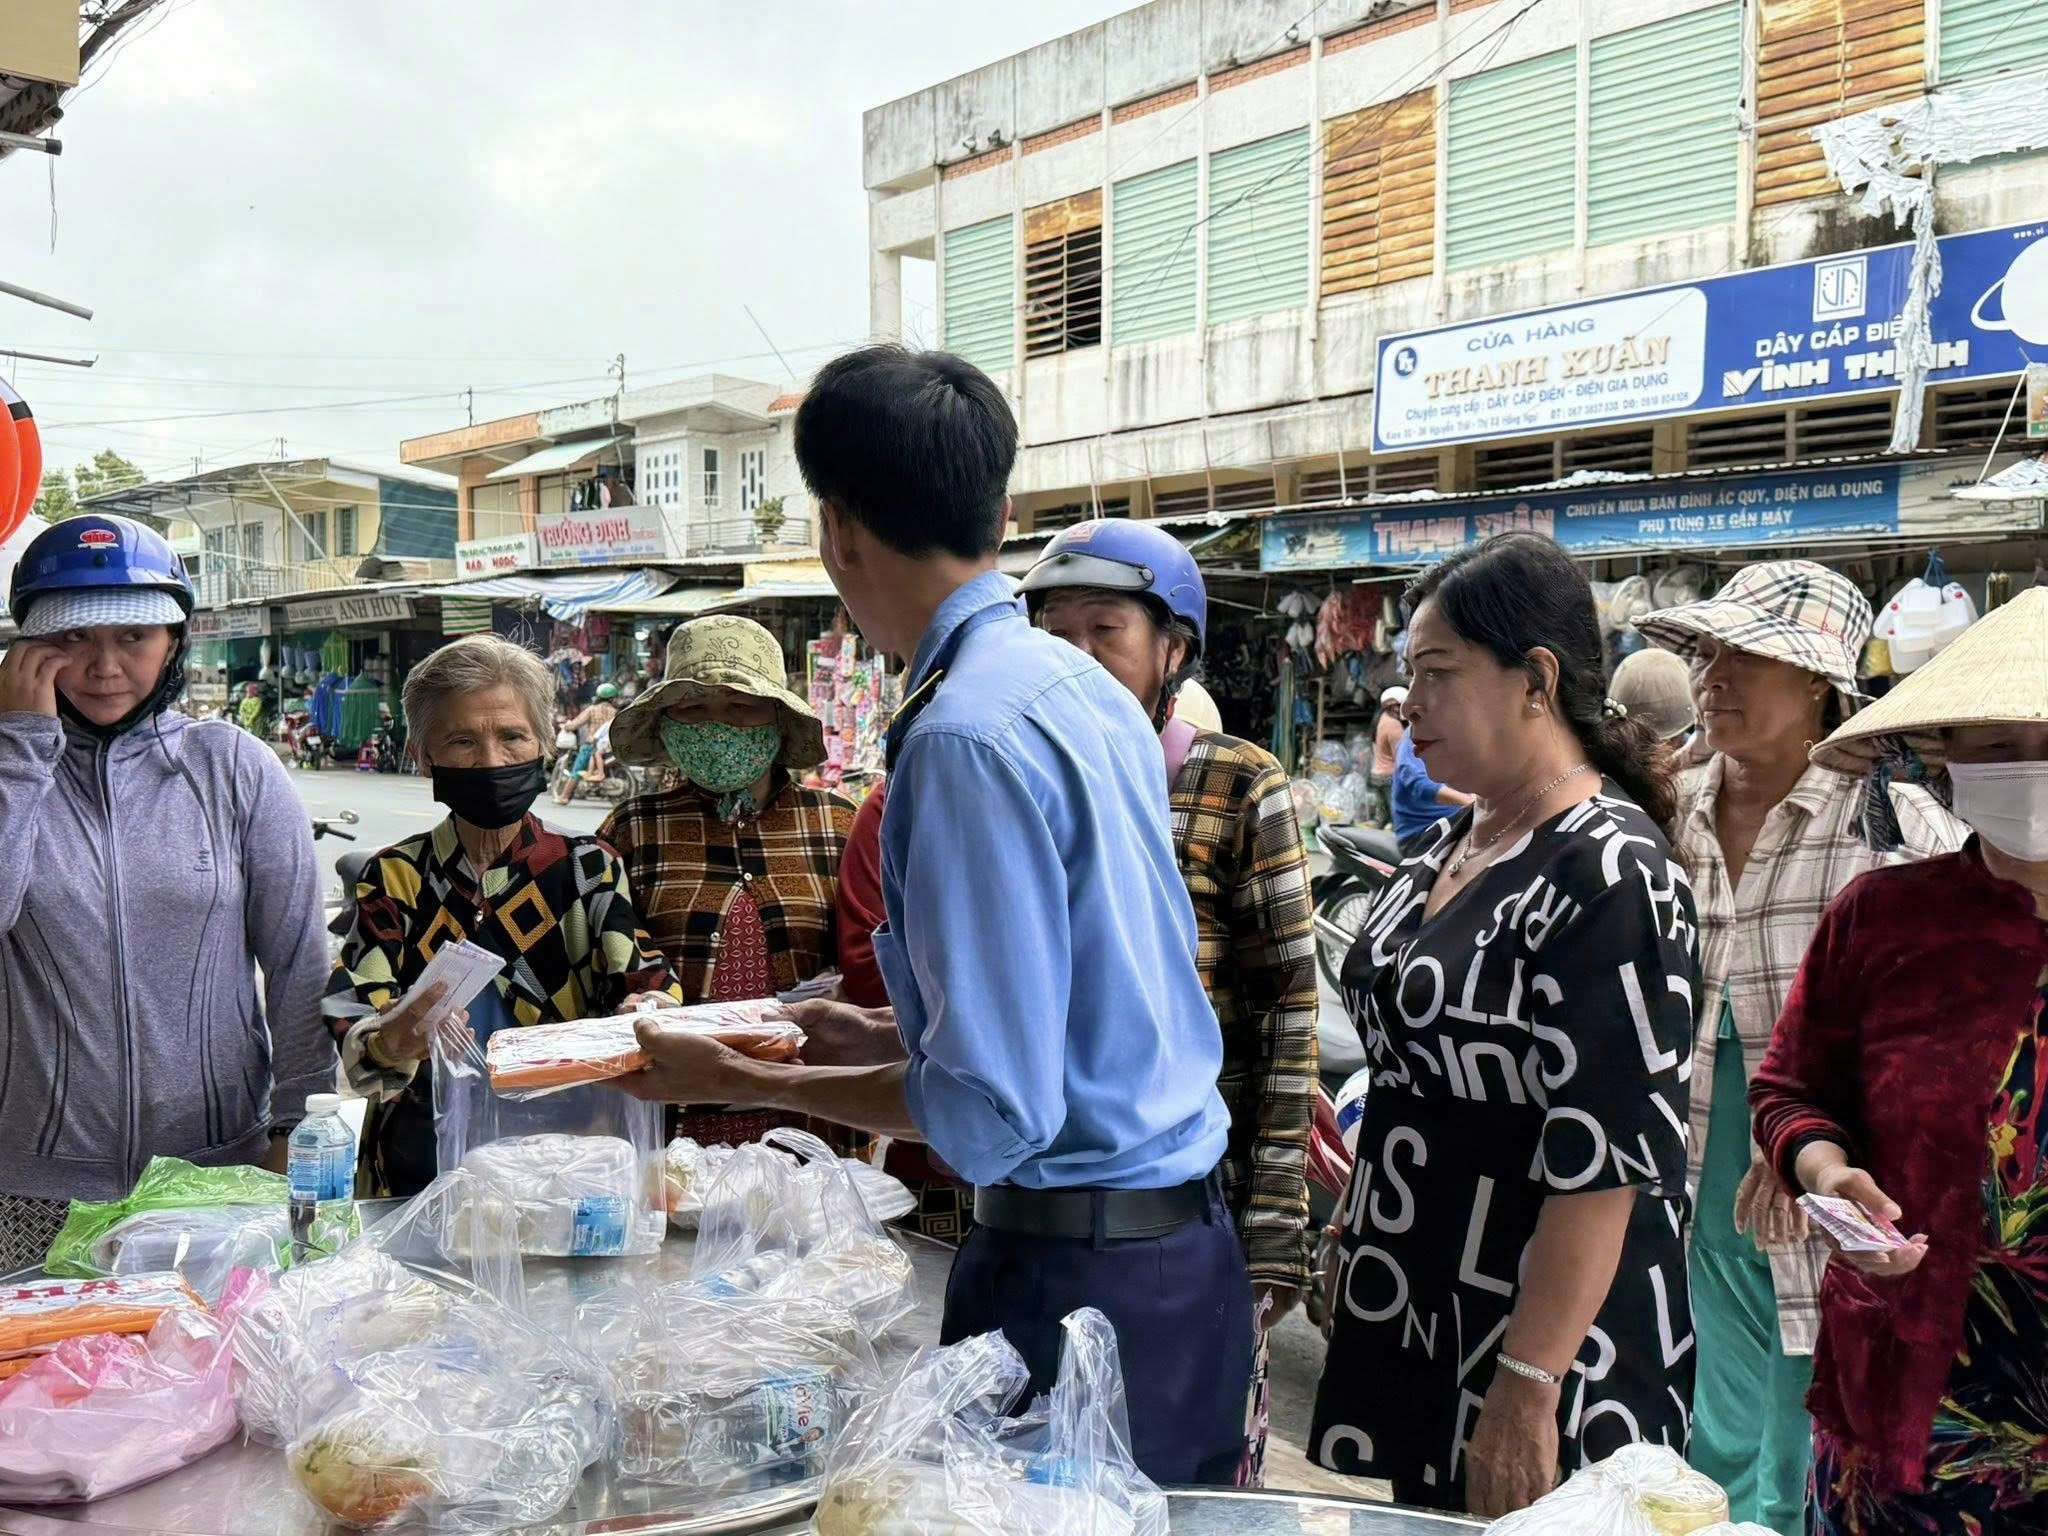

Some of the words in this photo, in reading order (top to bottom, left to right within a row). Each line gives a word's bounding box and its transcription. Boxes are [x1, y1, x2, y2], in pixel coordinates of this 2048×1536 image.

[1467, 330, 1514, 352] CỬA
[1526, 318, 1594, 343] HÀNG
[1756, 331, 1804, 358] DÂY
[1810, 322, 1859, 350] CÁP
[1866, 314, 1906, 345] ĐIỆ
[1424, 356, 1548, 399] THANH
[1487, 394, 1508, 410] DÂY
[1607, 378, 1628, 393] GIA
[1633, 372, 1668, 389] DỤNG
[1566, 499, 1615, 517] CHUYÊN
[1618, 498, 1645, 513] MUA
[1680, 491, 1712, 509] BÌNH
[1813, 484, 1837, 499] GIA
[1841, 479, 1883, 498] DỤNG
[1638, 517, 1666, 534] PHỤ
[1668, 513, 1705, 532] TÙNG
[1707, 514, 1726, 530] XE
[1761, 506, 1793, 526] MÁY
[340, 598, 368, 620] ANH
[372, 595, 403, 617] HUY
